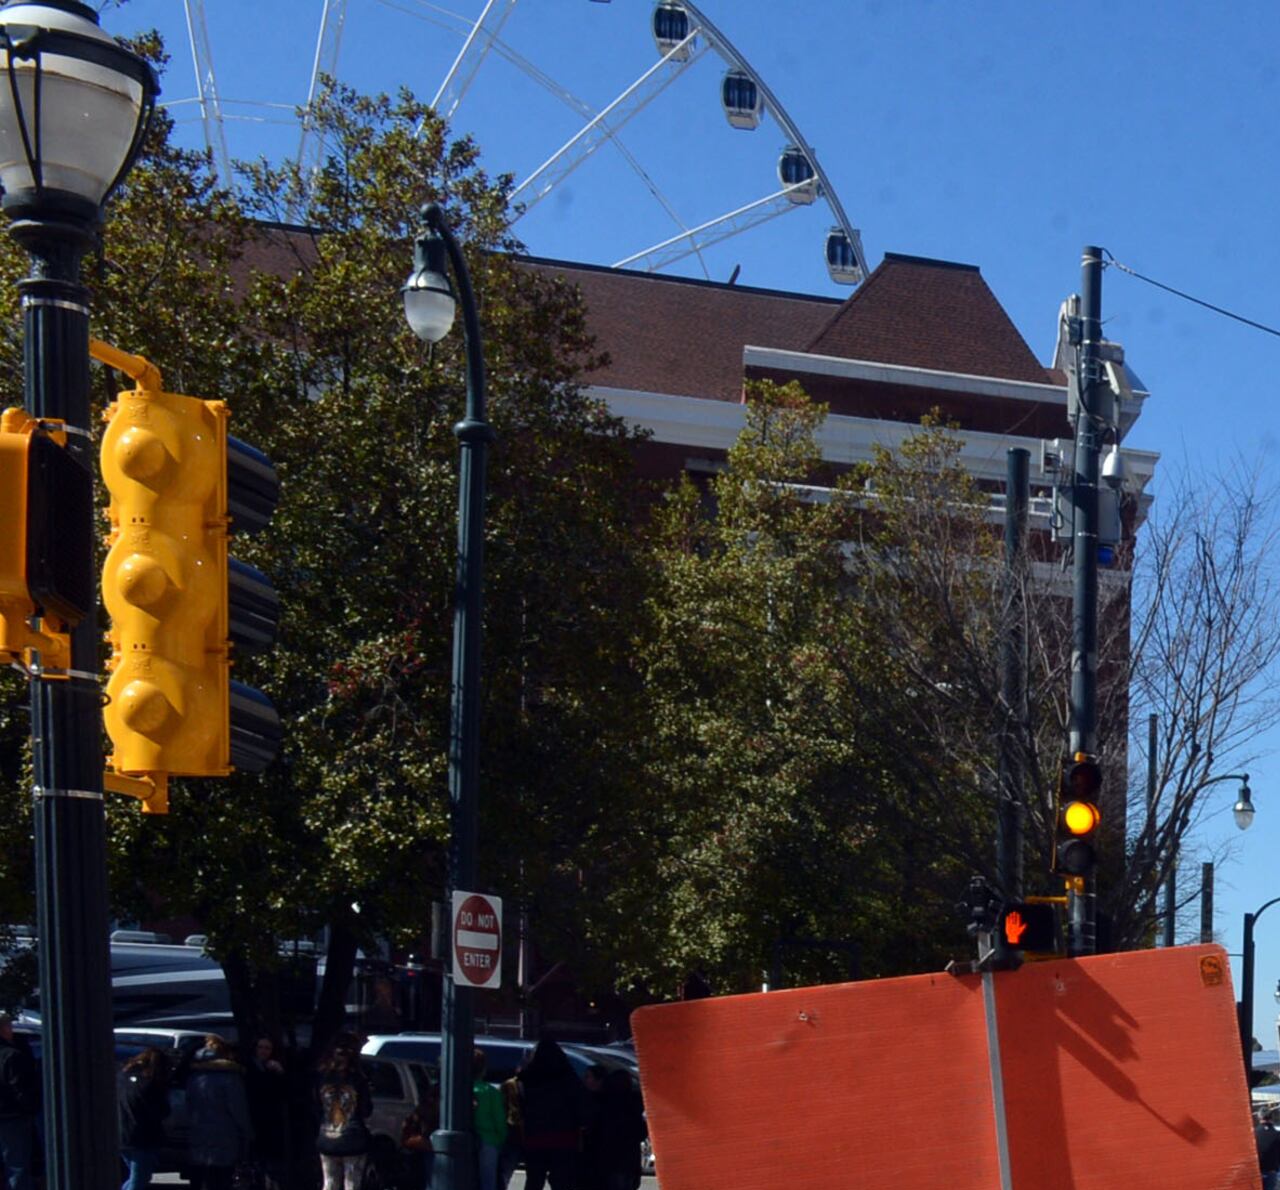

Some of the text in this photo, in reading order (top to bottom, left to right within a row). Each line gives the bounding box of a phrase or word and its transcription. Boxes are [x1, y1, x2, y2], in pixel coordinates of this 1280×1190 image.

[461, 912, 494, 928] DO NOT
[464, 953, 490, 968] ENTER
